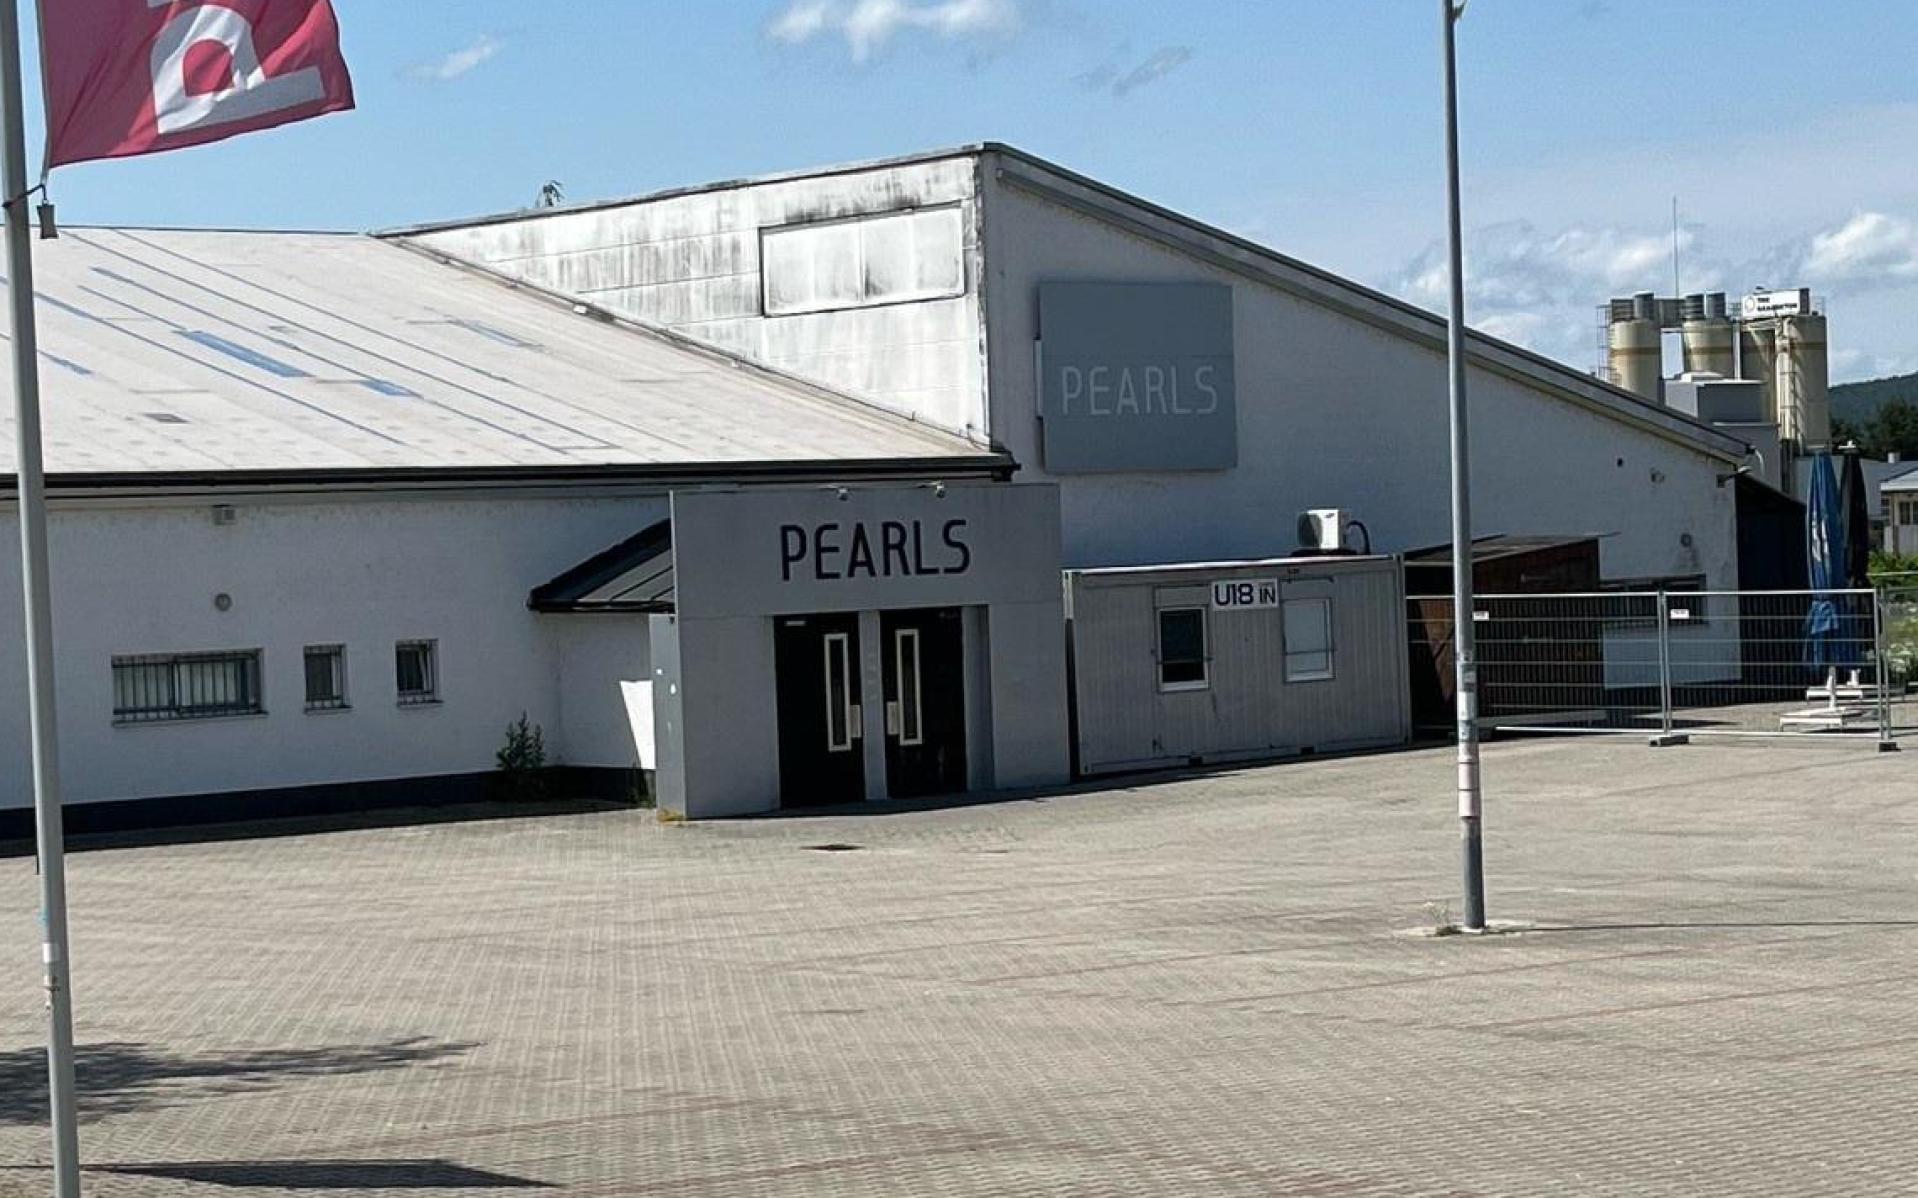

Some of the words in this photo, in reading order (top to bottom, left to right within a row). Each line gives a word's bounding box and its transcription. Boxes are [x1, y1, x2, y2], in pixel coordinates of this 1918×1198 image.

[1061, 365, 1218, 416] PEARLS
[780, 519, 970, 581] PEARLS
[1214, 583, 1254, 606] U18
